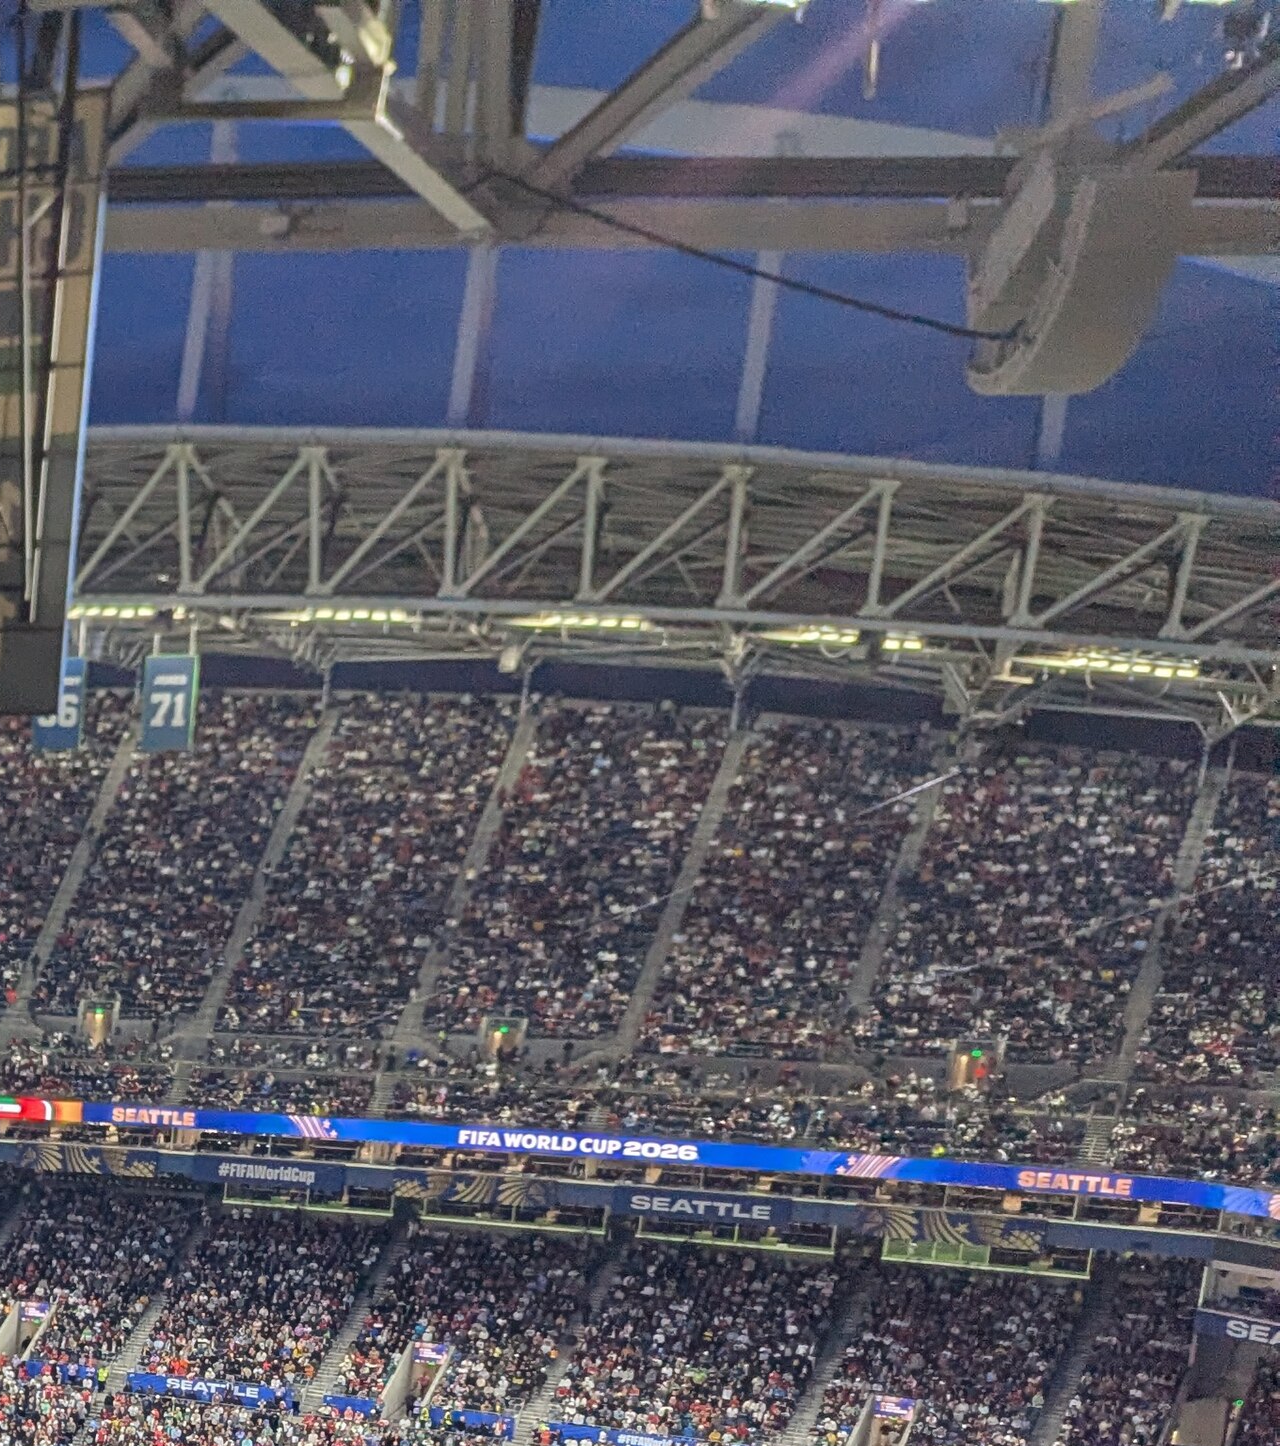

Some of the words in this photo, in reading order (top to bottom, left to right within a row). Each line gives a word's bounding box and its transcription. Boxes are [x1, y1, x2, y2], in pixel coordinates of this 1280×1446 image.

[149, 691, 186, 728] 71
[111, 1106, 196, 1127] SEATTLE
[458, 1129, 501, 1147] FIFA
[503, 1133, 582, 1155] WORLD
[584, 1137, 622, 1156] CUP
[622, 1141, 699, 1162] 2026
[218, 1161, 316, 1185] #FIFAWorldCup
[1017, 1170, 1134, 1197] SEATTLE
[629, 1194, 772, 1222] SEATTLE
[166, 1377, 260, 1399] SEATLE
